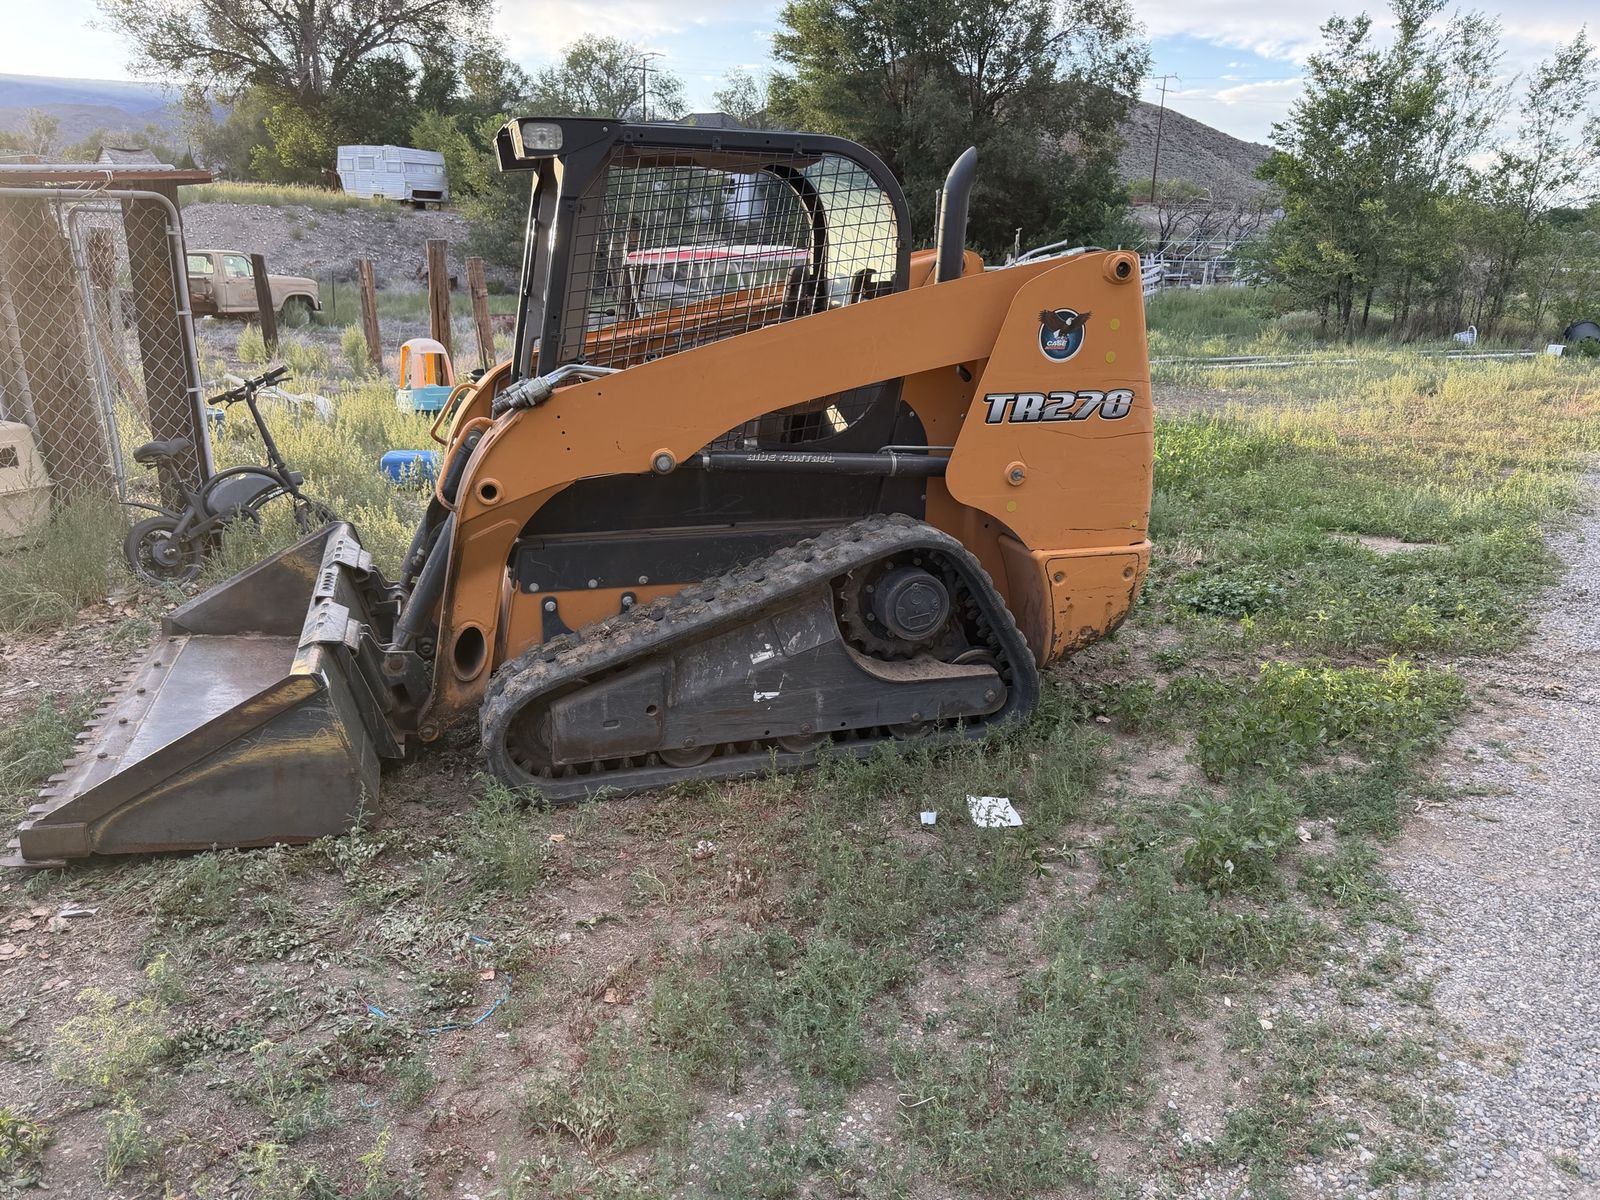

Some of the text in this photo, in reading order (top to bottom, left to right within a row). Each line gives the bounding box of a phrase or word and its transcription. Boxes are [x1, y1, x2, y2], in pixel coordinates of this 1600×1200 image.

[984, 389, 1135, 425] TR270
[746, 452, 836, 463] RIDE CONTROL
